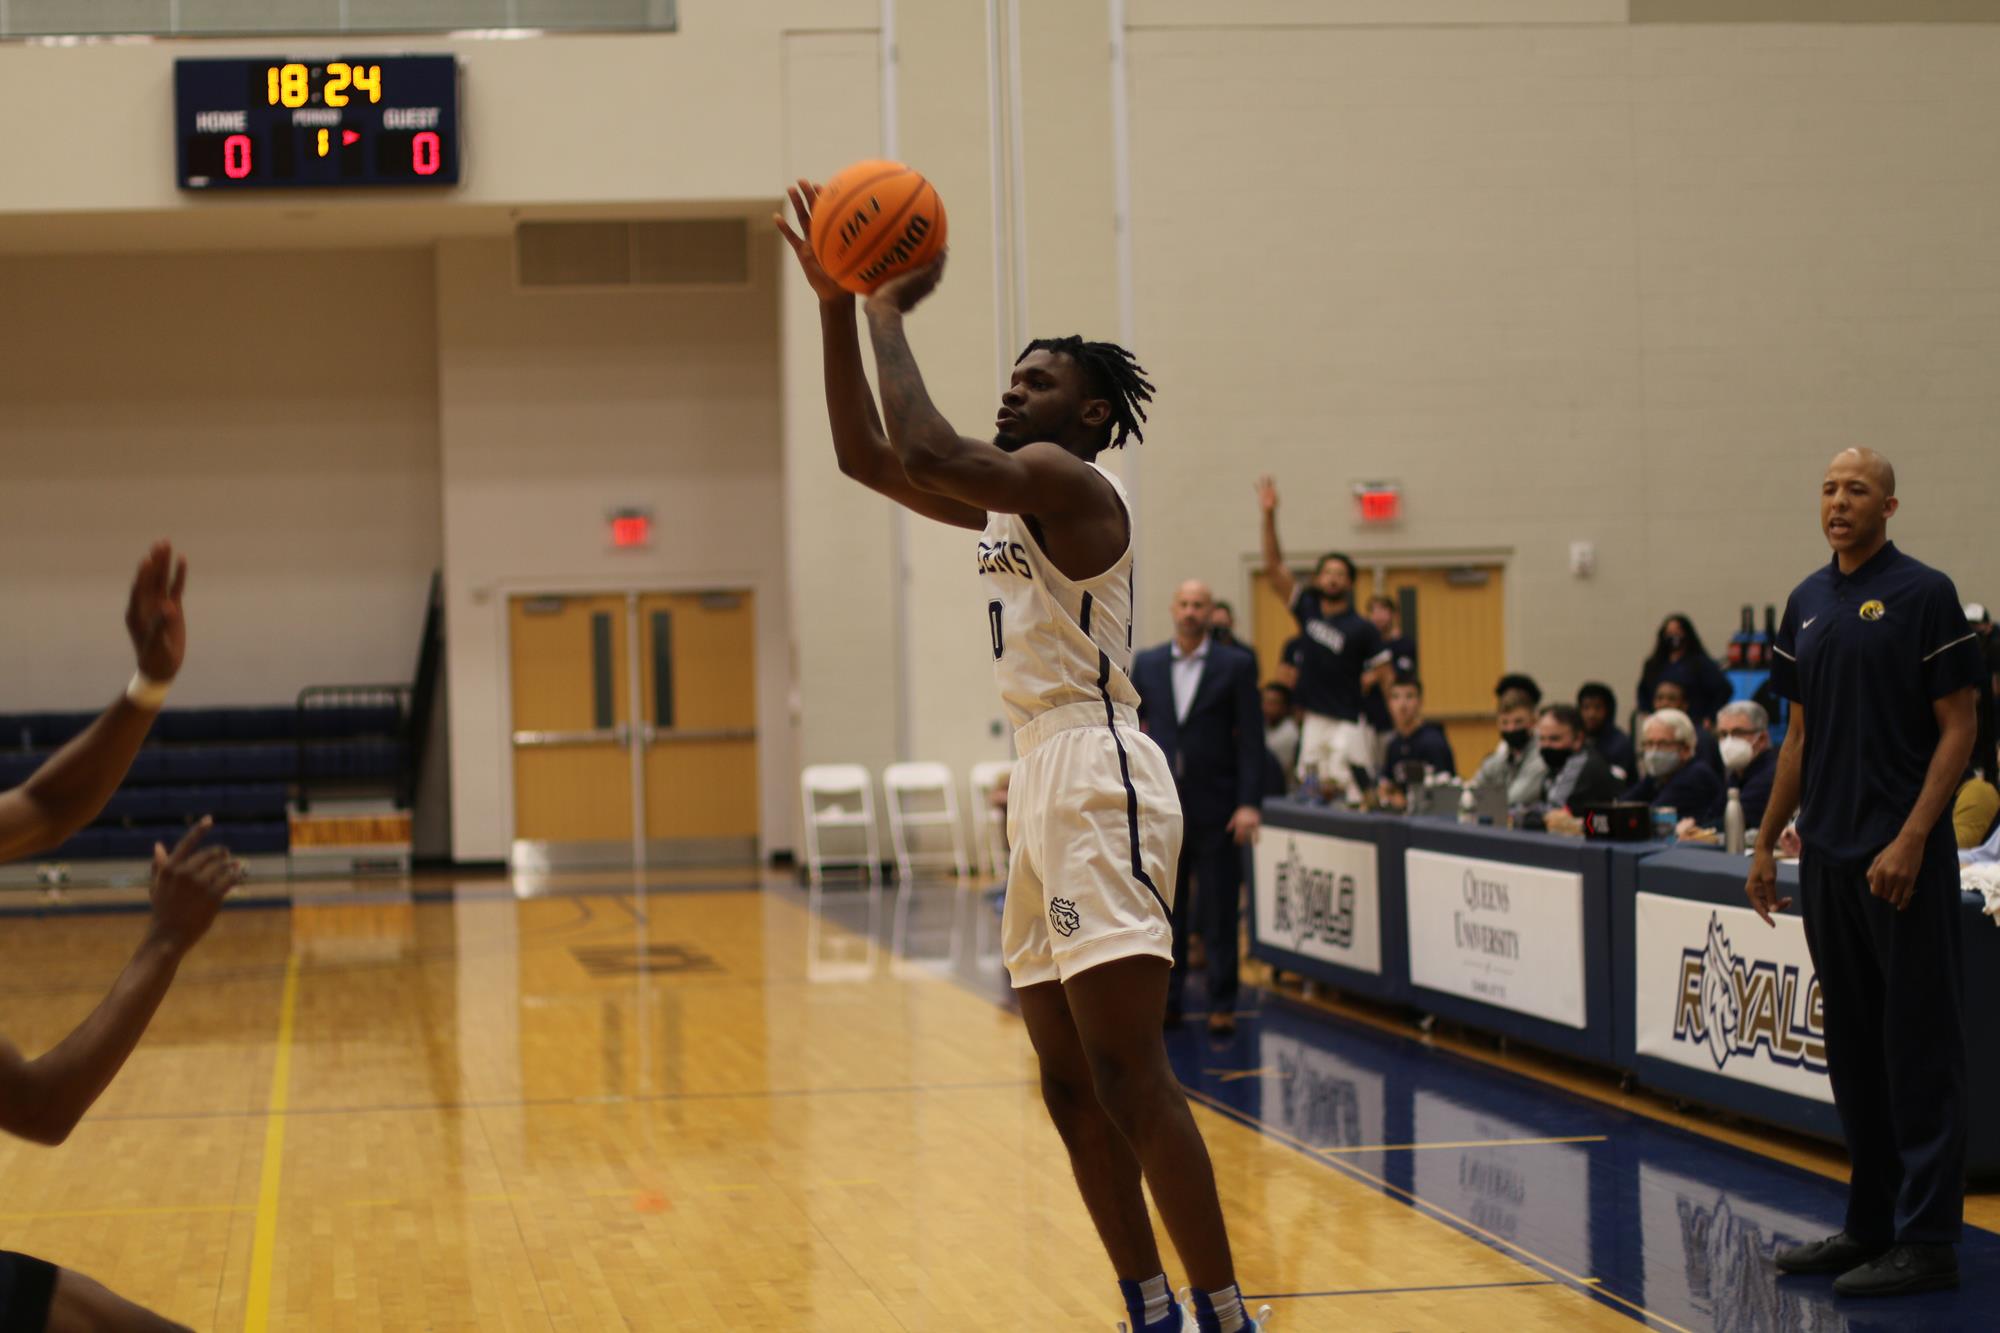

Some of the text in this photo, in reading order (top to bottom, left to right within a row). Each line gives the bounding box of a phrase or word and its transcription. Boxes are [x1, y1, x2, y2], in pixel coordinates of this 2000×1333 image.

[267, 63, 382, 108] 18:24
[196, 111, 248, 131] HOME
[383, 109, 440, 129] GUEST
[224, 134, 252, 178] 0
[317, 127, 329, 157] 1
[412, 132, 440, 175] 0
